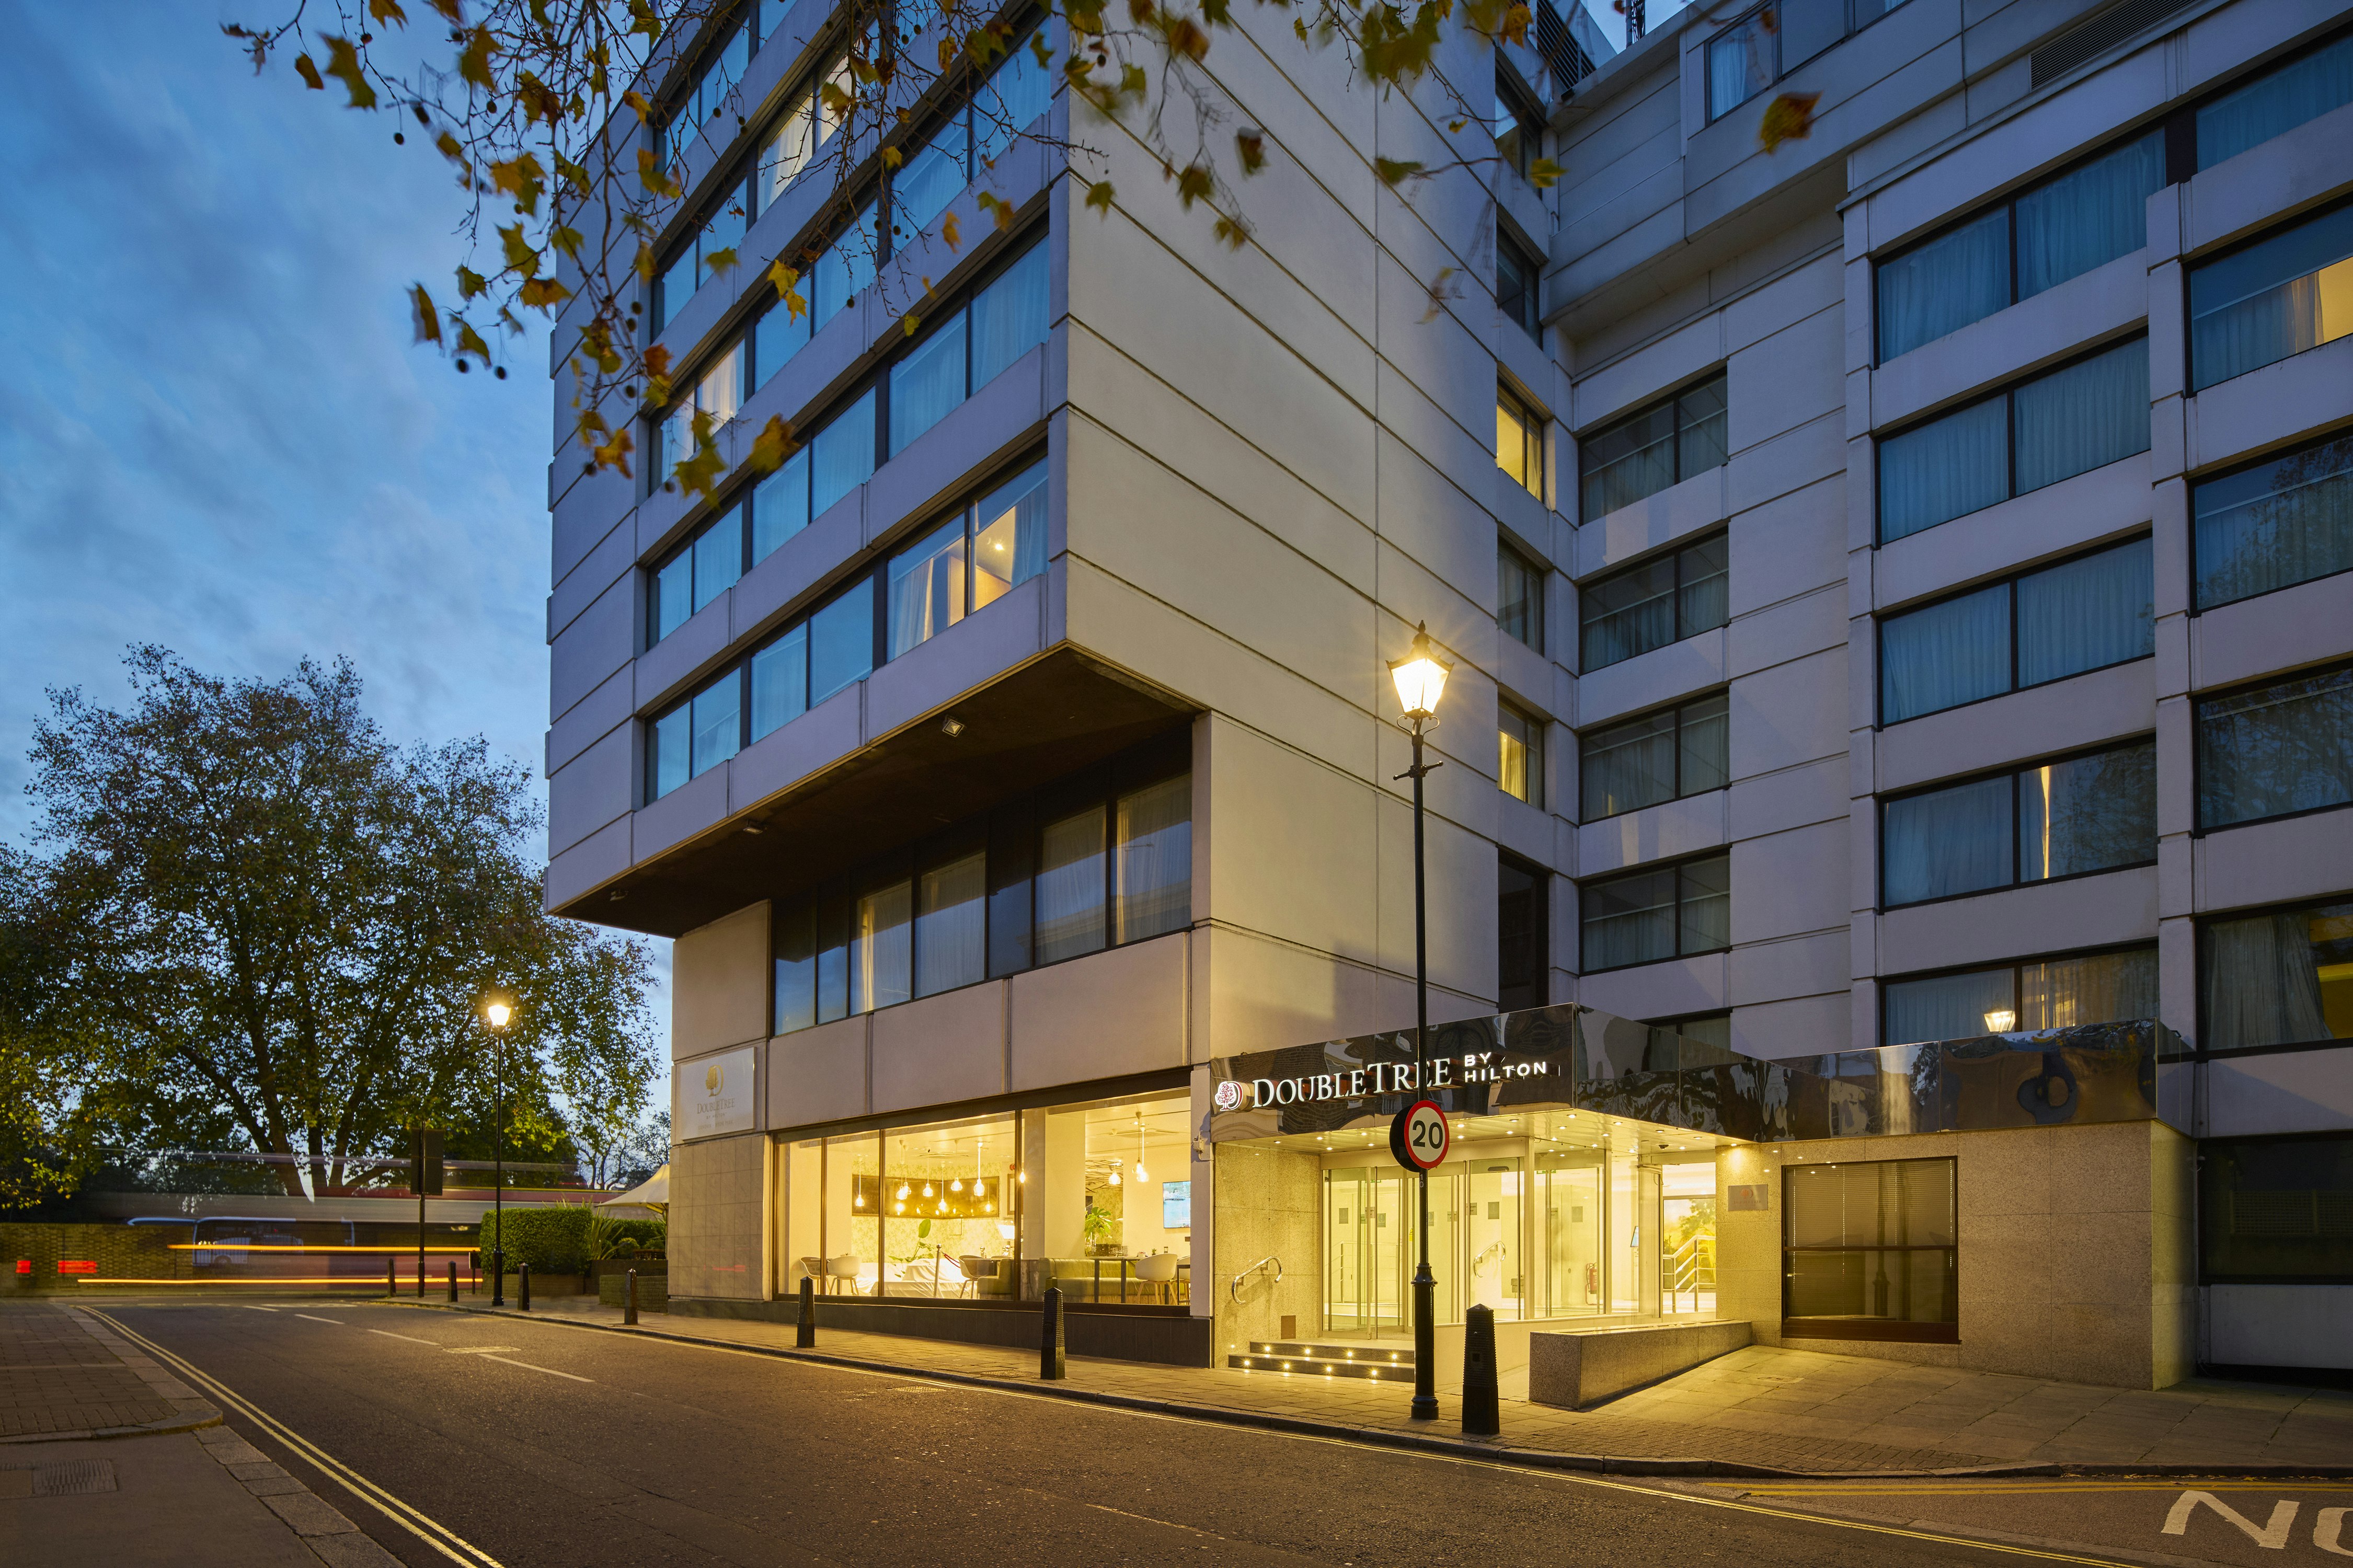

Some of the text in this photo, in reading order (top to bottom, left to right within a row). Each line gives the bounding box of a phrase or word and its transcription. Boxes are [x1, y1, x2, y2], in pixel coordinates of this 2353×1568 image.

[1465, 1052, 1491, 1067] BY
[1465, 1062, 1546, 1082] HILTON
[697, 1098, 735, 1114] DOUBLETREE
[1413, 1120, 1443, 1149] 20
